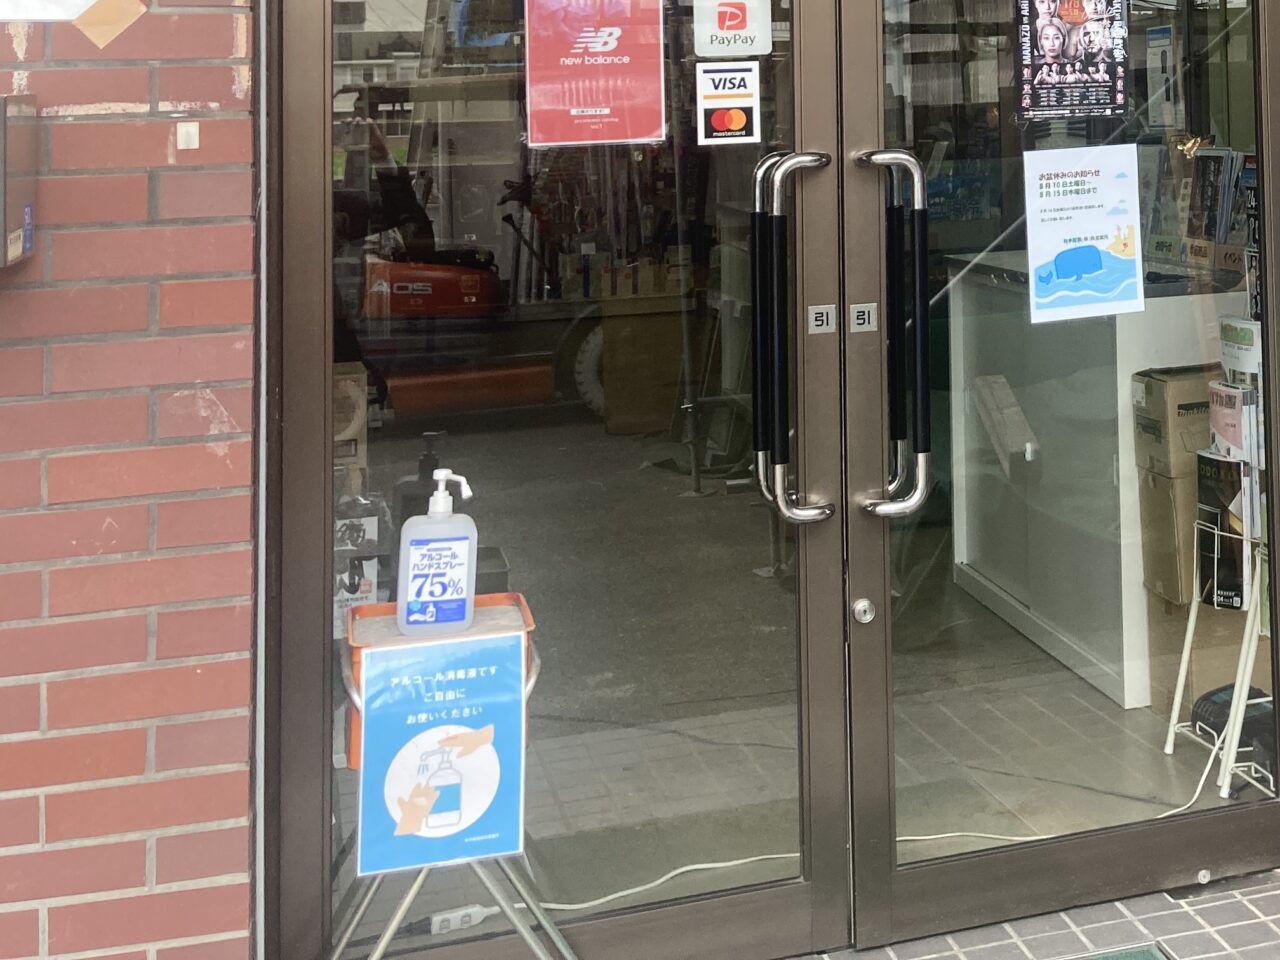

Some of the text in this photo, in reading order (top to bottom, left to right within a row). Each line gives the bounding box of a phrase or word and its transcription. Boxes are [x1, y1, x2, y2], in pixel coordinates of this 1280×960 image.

[710, 34, 757, 46] PayPay
[560, 55, 630, 65] new balance
[709, 77, 748, 90] VISA
[814, 311, 829, 327] 引
[856, 310, 871, 325] 引
[419, 552, 459, 562] アルコール
[412, 561, 464, 571] ハンドスプレー
[411, 572, 464, 599] 75%
[390, 665, 499, 687] アルコール消毒液です
[423, 688, 466, 702] ご自由に
[406, 706, 483, 724] お使いください
